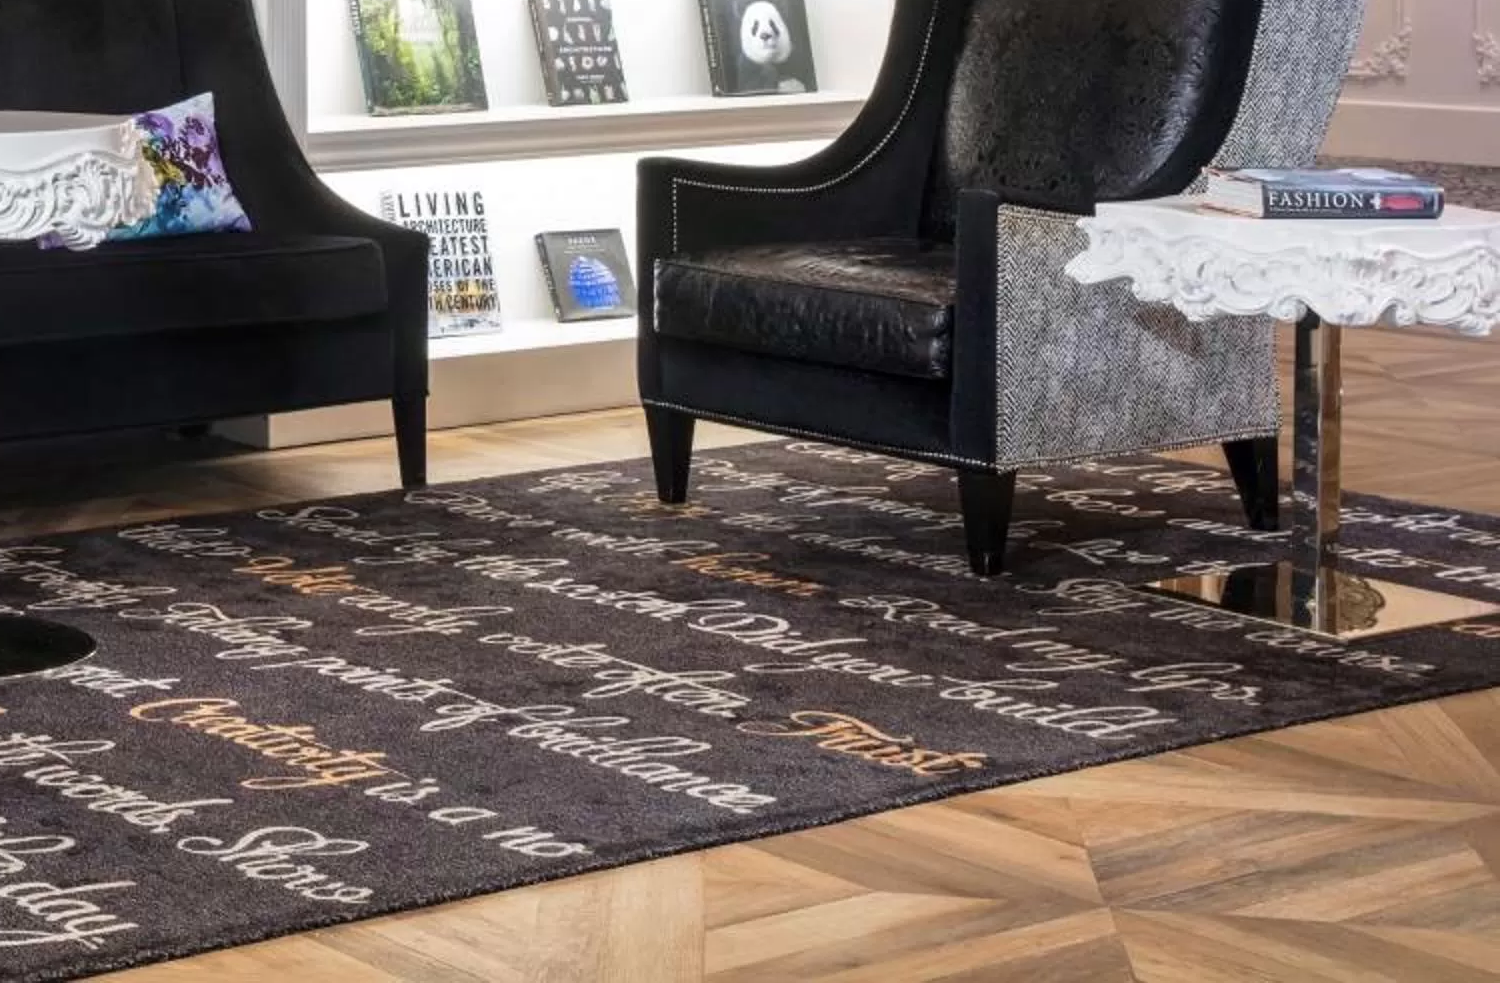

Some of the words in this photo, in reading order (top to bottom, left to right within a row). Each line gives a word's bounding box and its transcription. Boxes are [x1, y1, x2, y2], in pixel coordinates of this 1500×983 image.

[398, 191, 485, 217] LIVING
[1268, 191, 1364, 209] FASHION
[402, 218, 488, 234] ARCHITECTURE
[429, 235, 489, 256] EATEST
[428, 257, 493, 278] ERICAN
[454, 555, 569, 581] the
[687, 614, 868, 655] Did
[839, 595, 1055, 640] Read
[232, 556, 364, 595] Vote
[478, 632, 630, 669] vote
[736, 711, 987, 775] Trust
[744, 652, 933, 685] you
[118, 602, 313, 659] Talking
[252, 656, 447, 702] points
[506, 717, 777, 814] brilliance.
[938, 678, 1176, 740] build
[128, 696, 407, 790] Creativity
[364, 780, 440, 805] is
[428, 806, 499, 826] a
[482, 826, 592, 857] no
[25, 763, 234, 833] words.
[176, 825, 373, 904] Show
